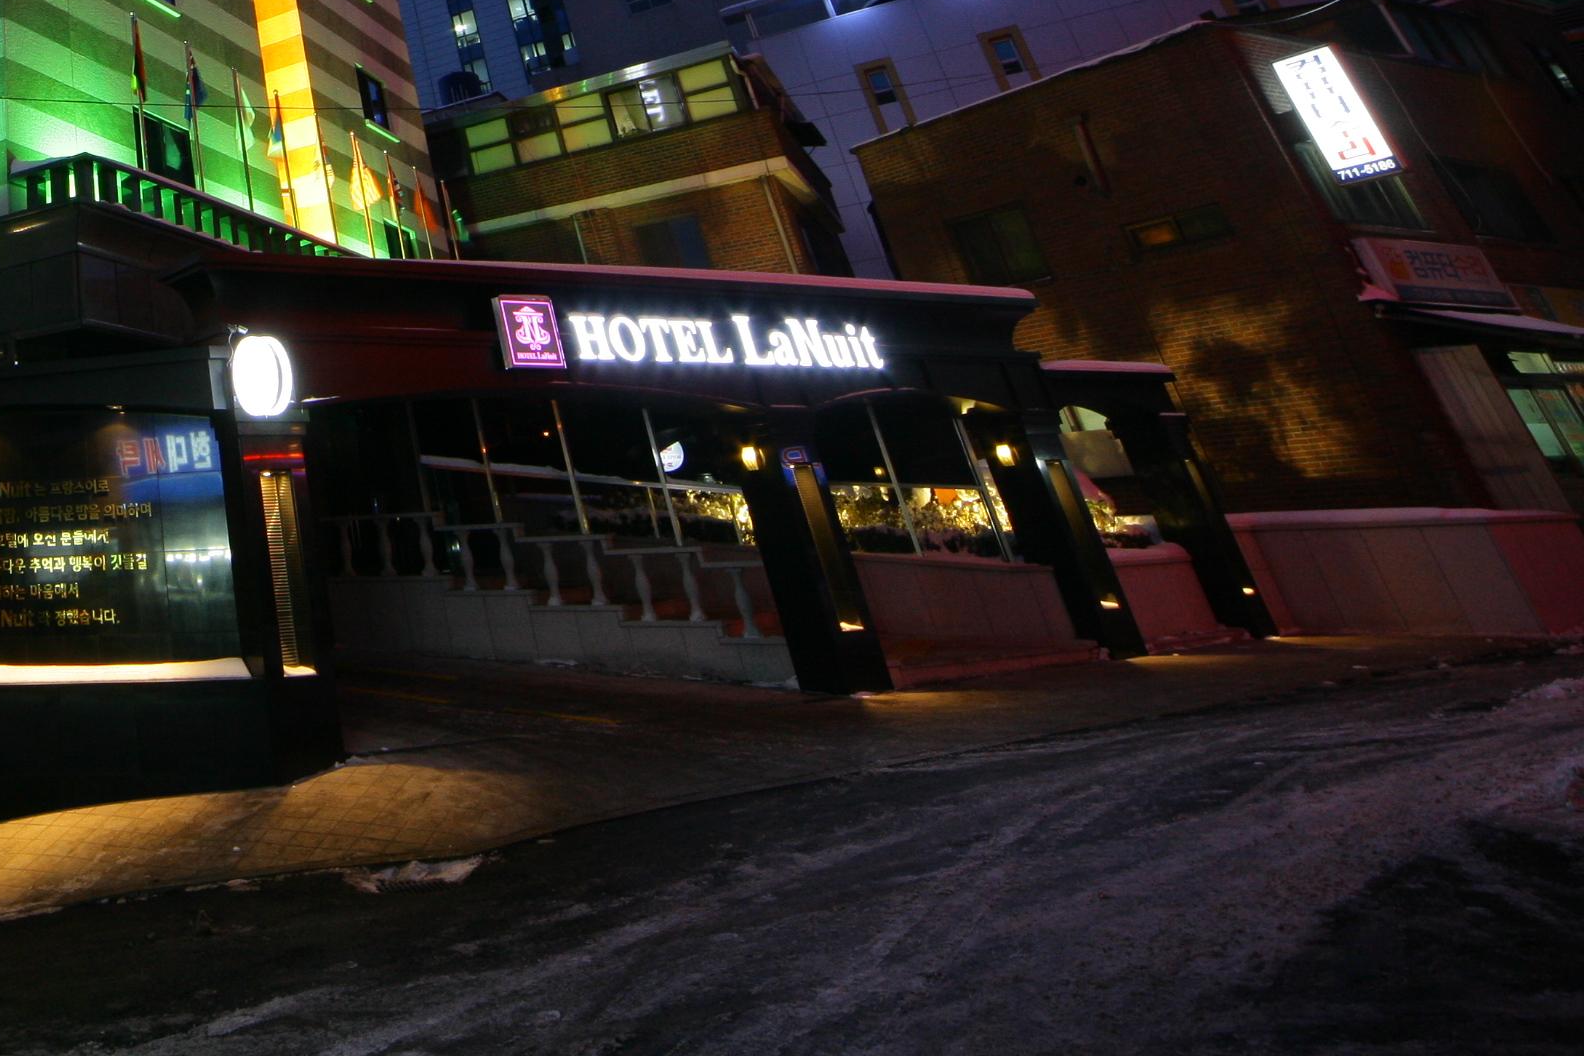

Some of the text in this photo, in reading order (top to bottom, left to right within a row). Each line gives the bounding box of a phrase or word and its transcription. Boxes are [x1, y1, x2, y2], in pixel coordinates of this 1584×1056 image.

[569, 313, 885, 369] HOTEL LaNuit
[103, 502, 152, 519] 의미하며
[32, 531, 56, 546] 오신
[28, 555, 65, 573] 추억과
[69, 554, 106, 572] 행복이
[30, 582, 79, 599] 마음에서
